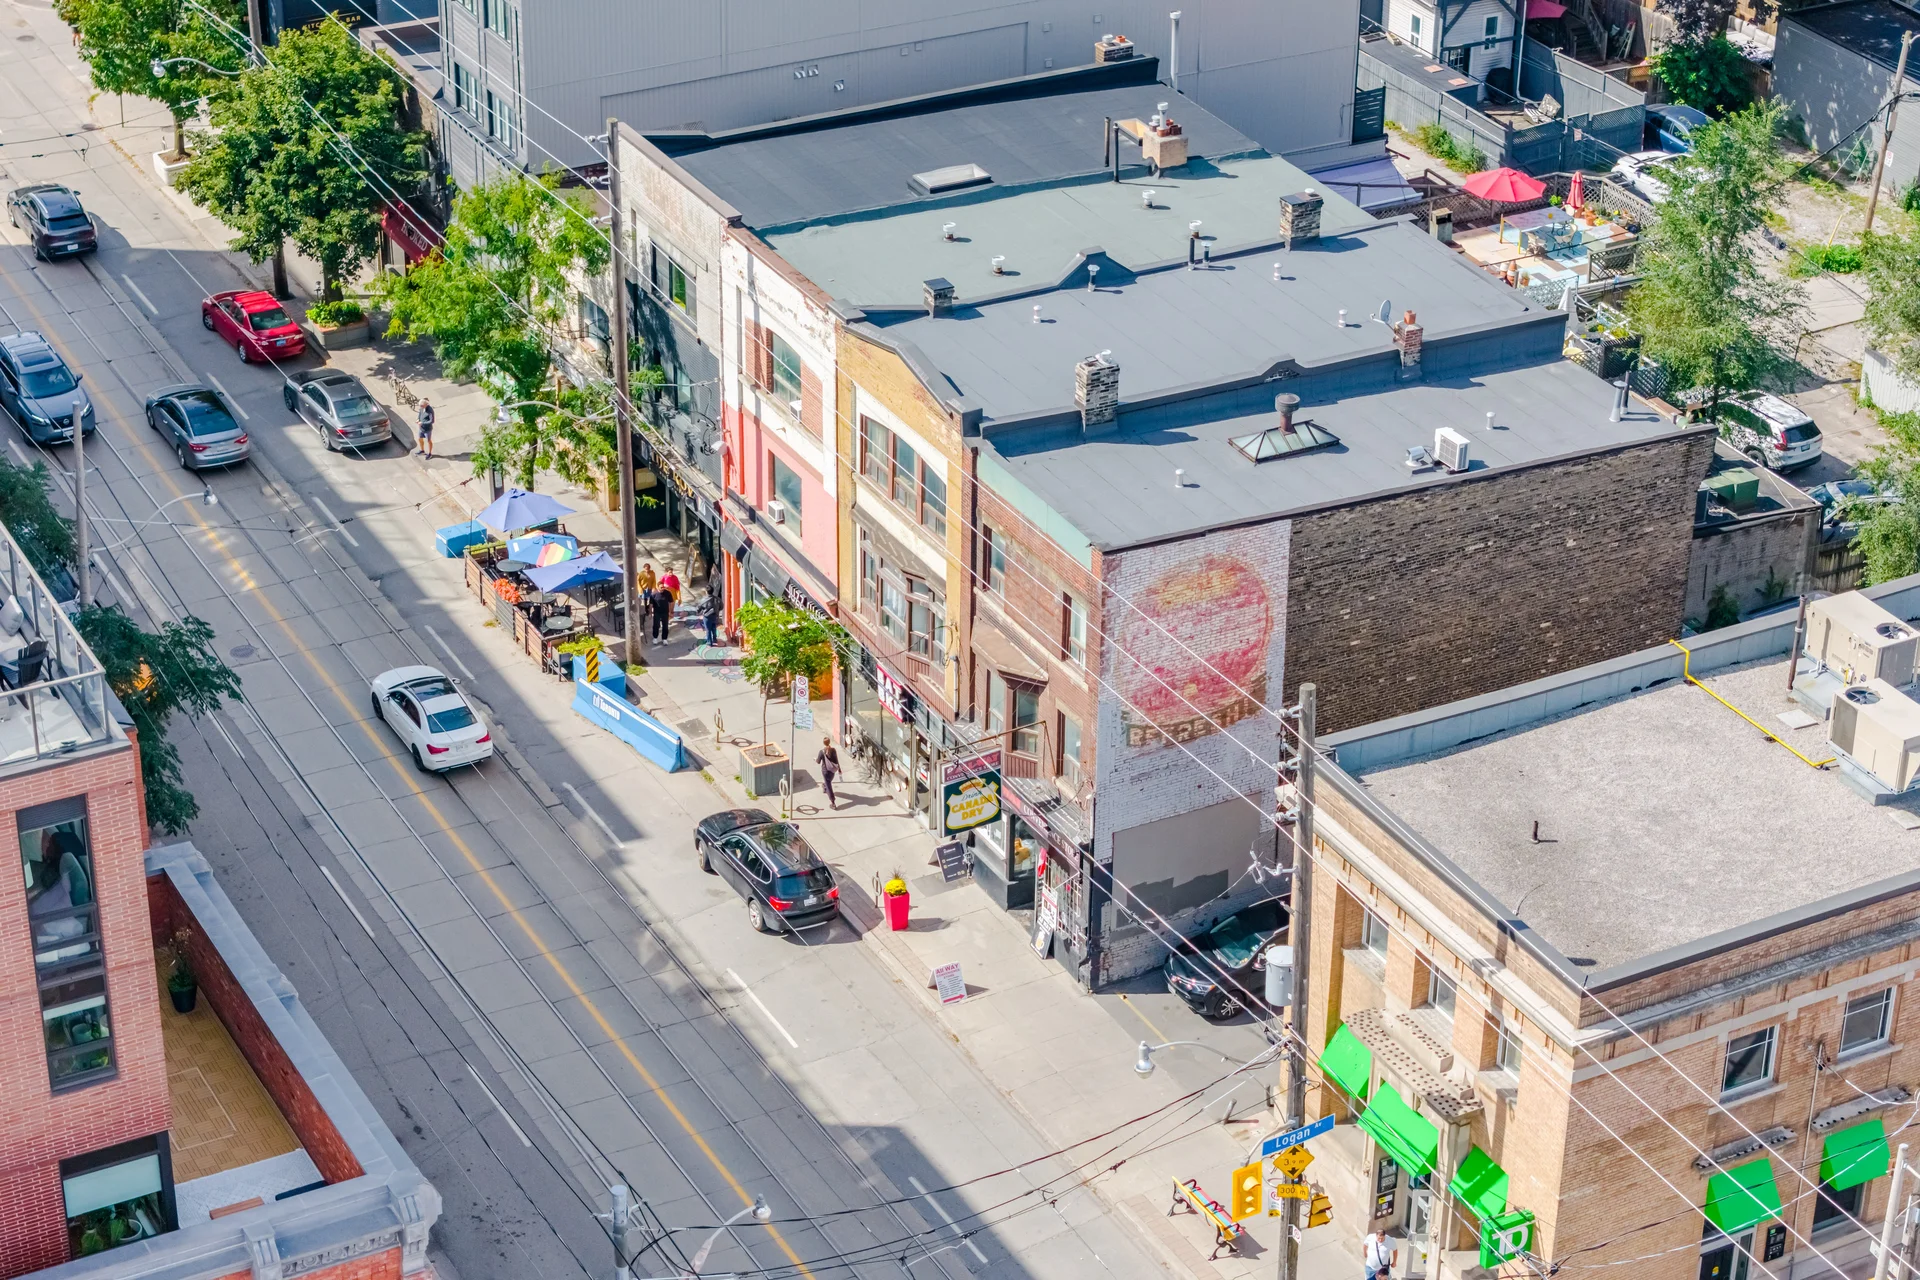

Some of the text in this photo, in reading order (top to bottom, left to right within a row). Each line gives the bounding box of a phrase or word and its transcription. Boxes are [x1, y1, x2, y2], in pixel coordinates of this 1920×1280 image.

[345, 15, 361, 23] BAR
[877, 667, 902, 700] EAT
[951, 794, 993, 814] CANADA
[961, 806, 985, 821] DRY
[944, 963, 959, 971] WAY
[1275, 1121, 1322, 1148] Logan Av
[1280, 1186, 1296, 1194] 300
[1491, 1225, 1529, 1257] TD
